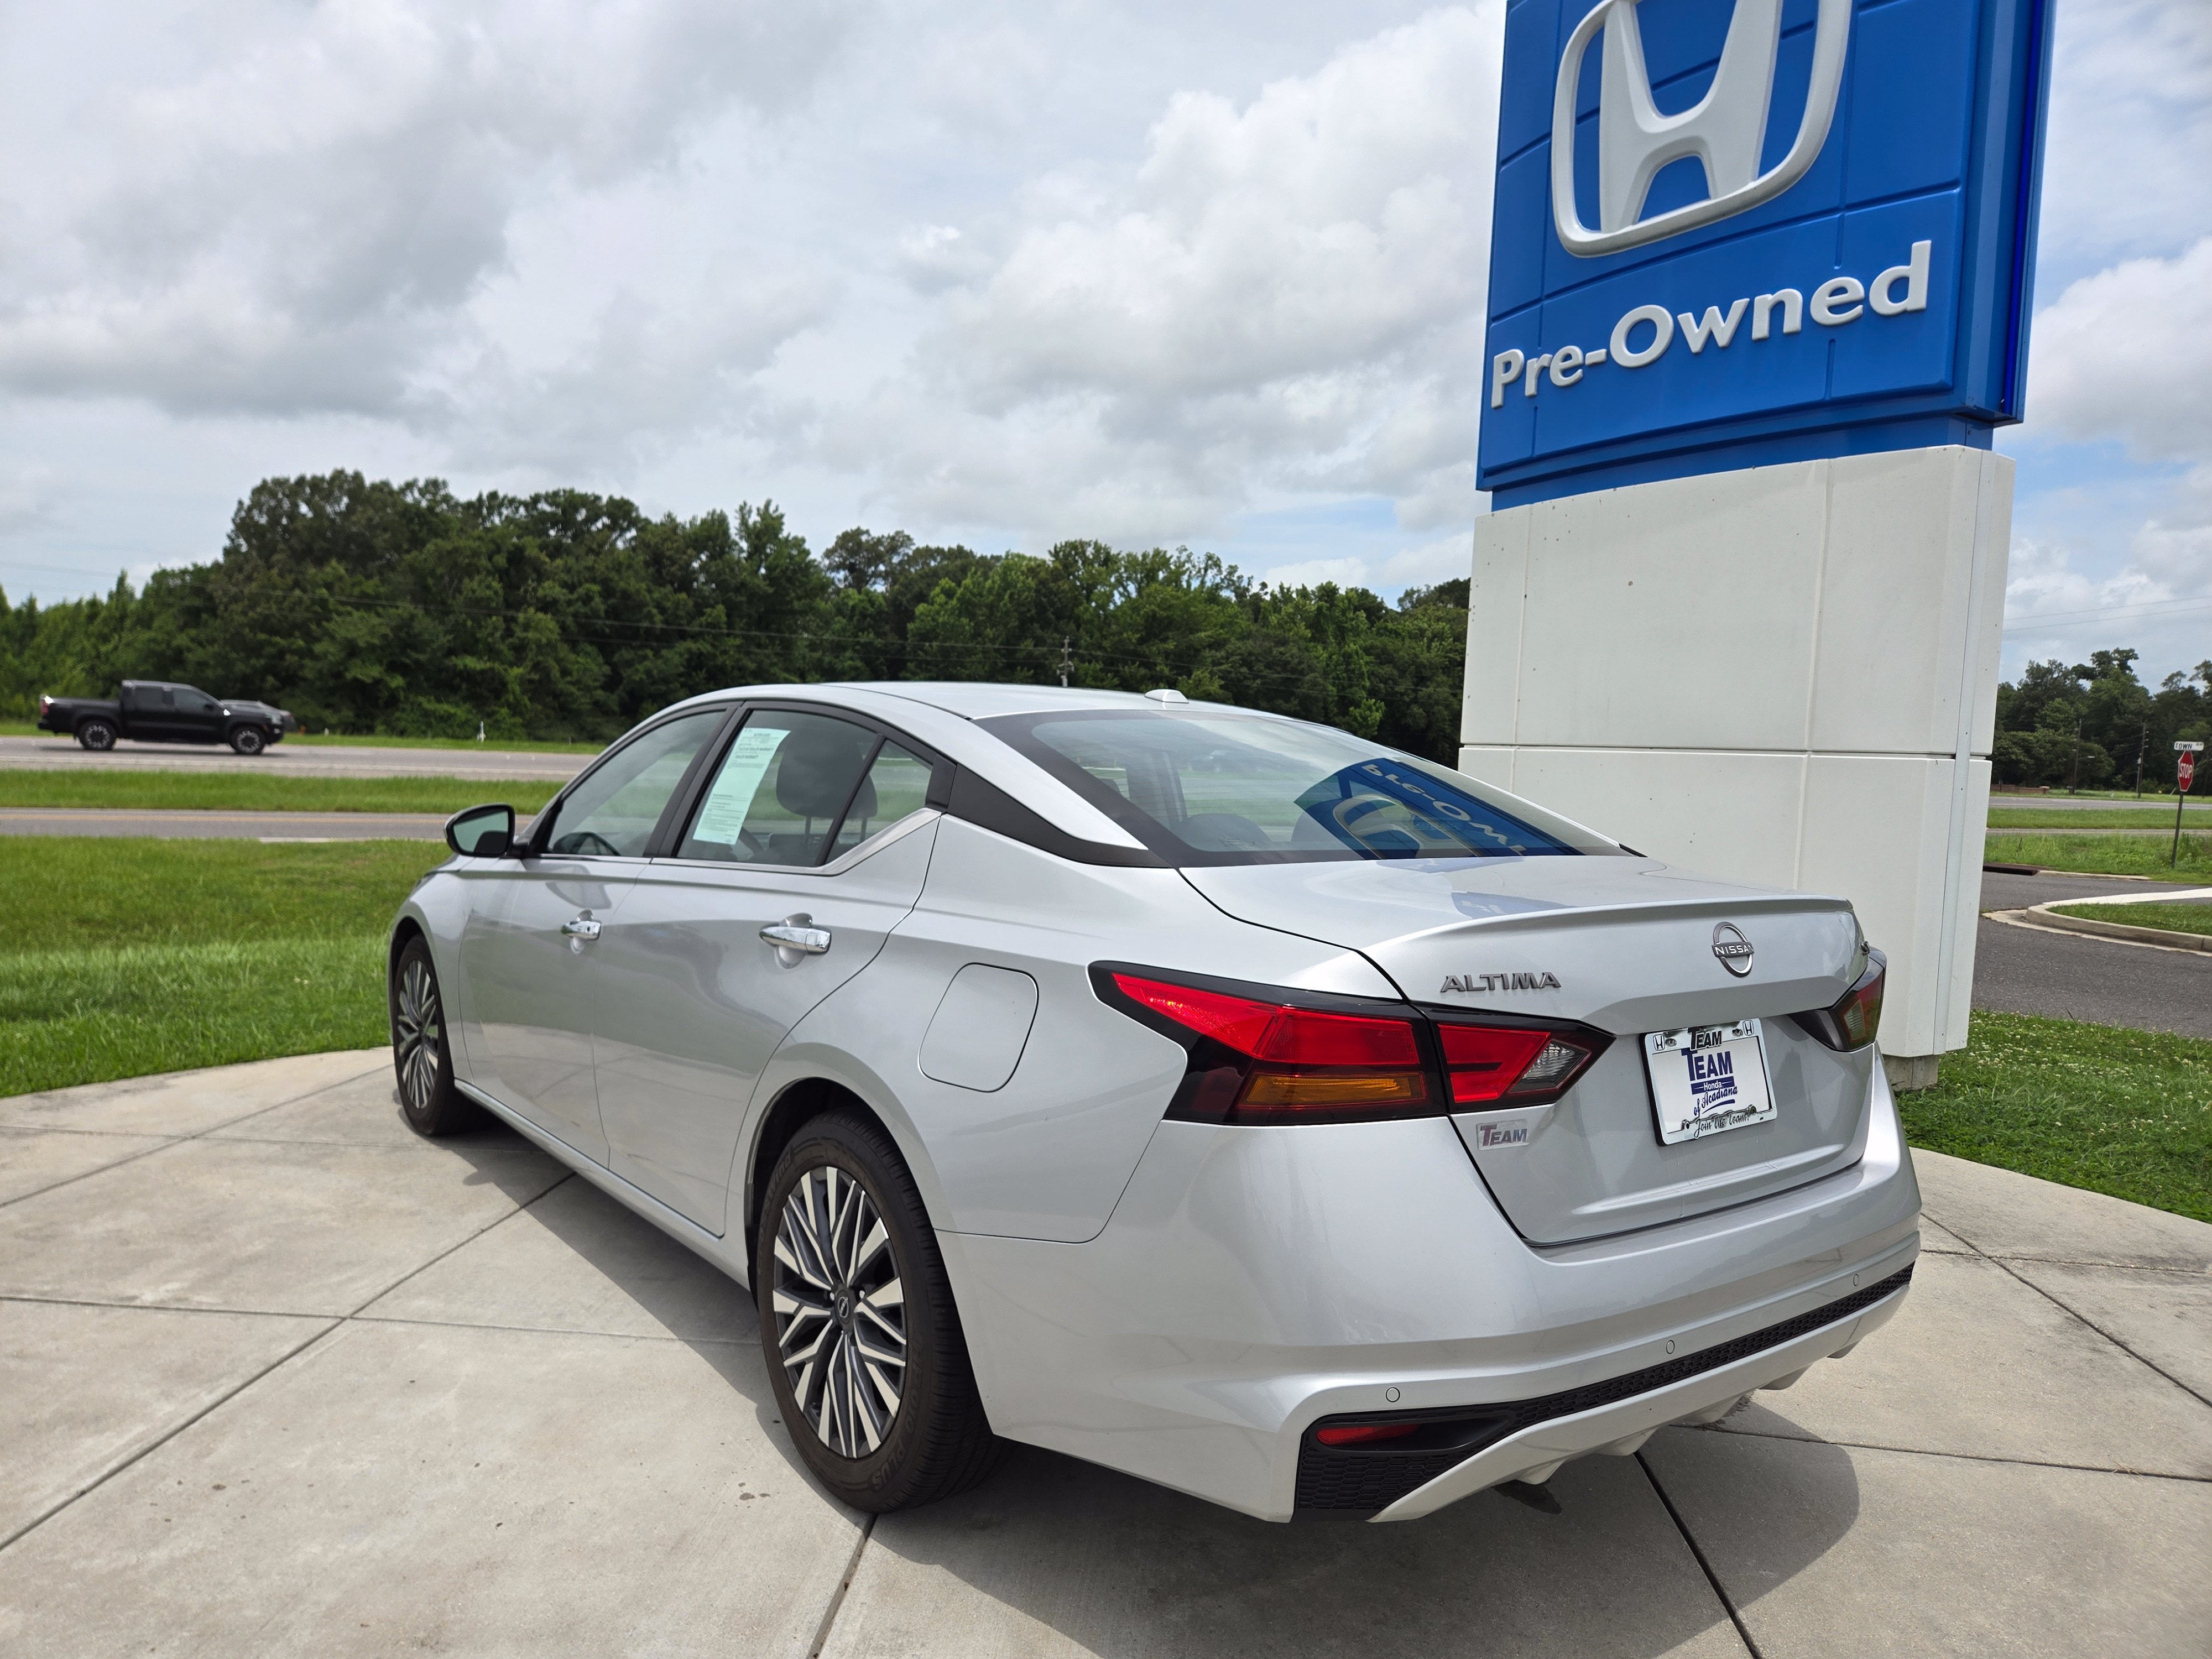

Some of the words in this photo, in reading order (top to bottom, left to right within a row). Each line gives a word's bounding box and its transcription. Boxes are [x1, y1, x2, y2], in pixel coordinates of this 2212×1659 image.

[1491, 239, 1932, 409] Pre-Owned
[2179, 763, 2193, 779] STOP
[1440, 972, 1562, 993] ALTIMA
[1687, 1027, 1723, 1050] TEAM
[1681, 1048, 1733, 1082] TEAM
[1703, 1080, 1723, 1091] Honda
[1694, 1098, 1700, 1117] of
[1702, 1086, 1738, 1108] Acadiana
[1480, 1123, 1528, 1147] TEAM
[1694, 1118, 1712, 1138] Join
[872, 1437, 907, 1492] PLUS
